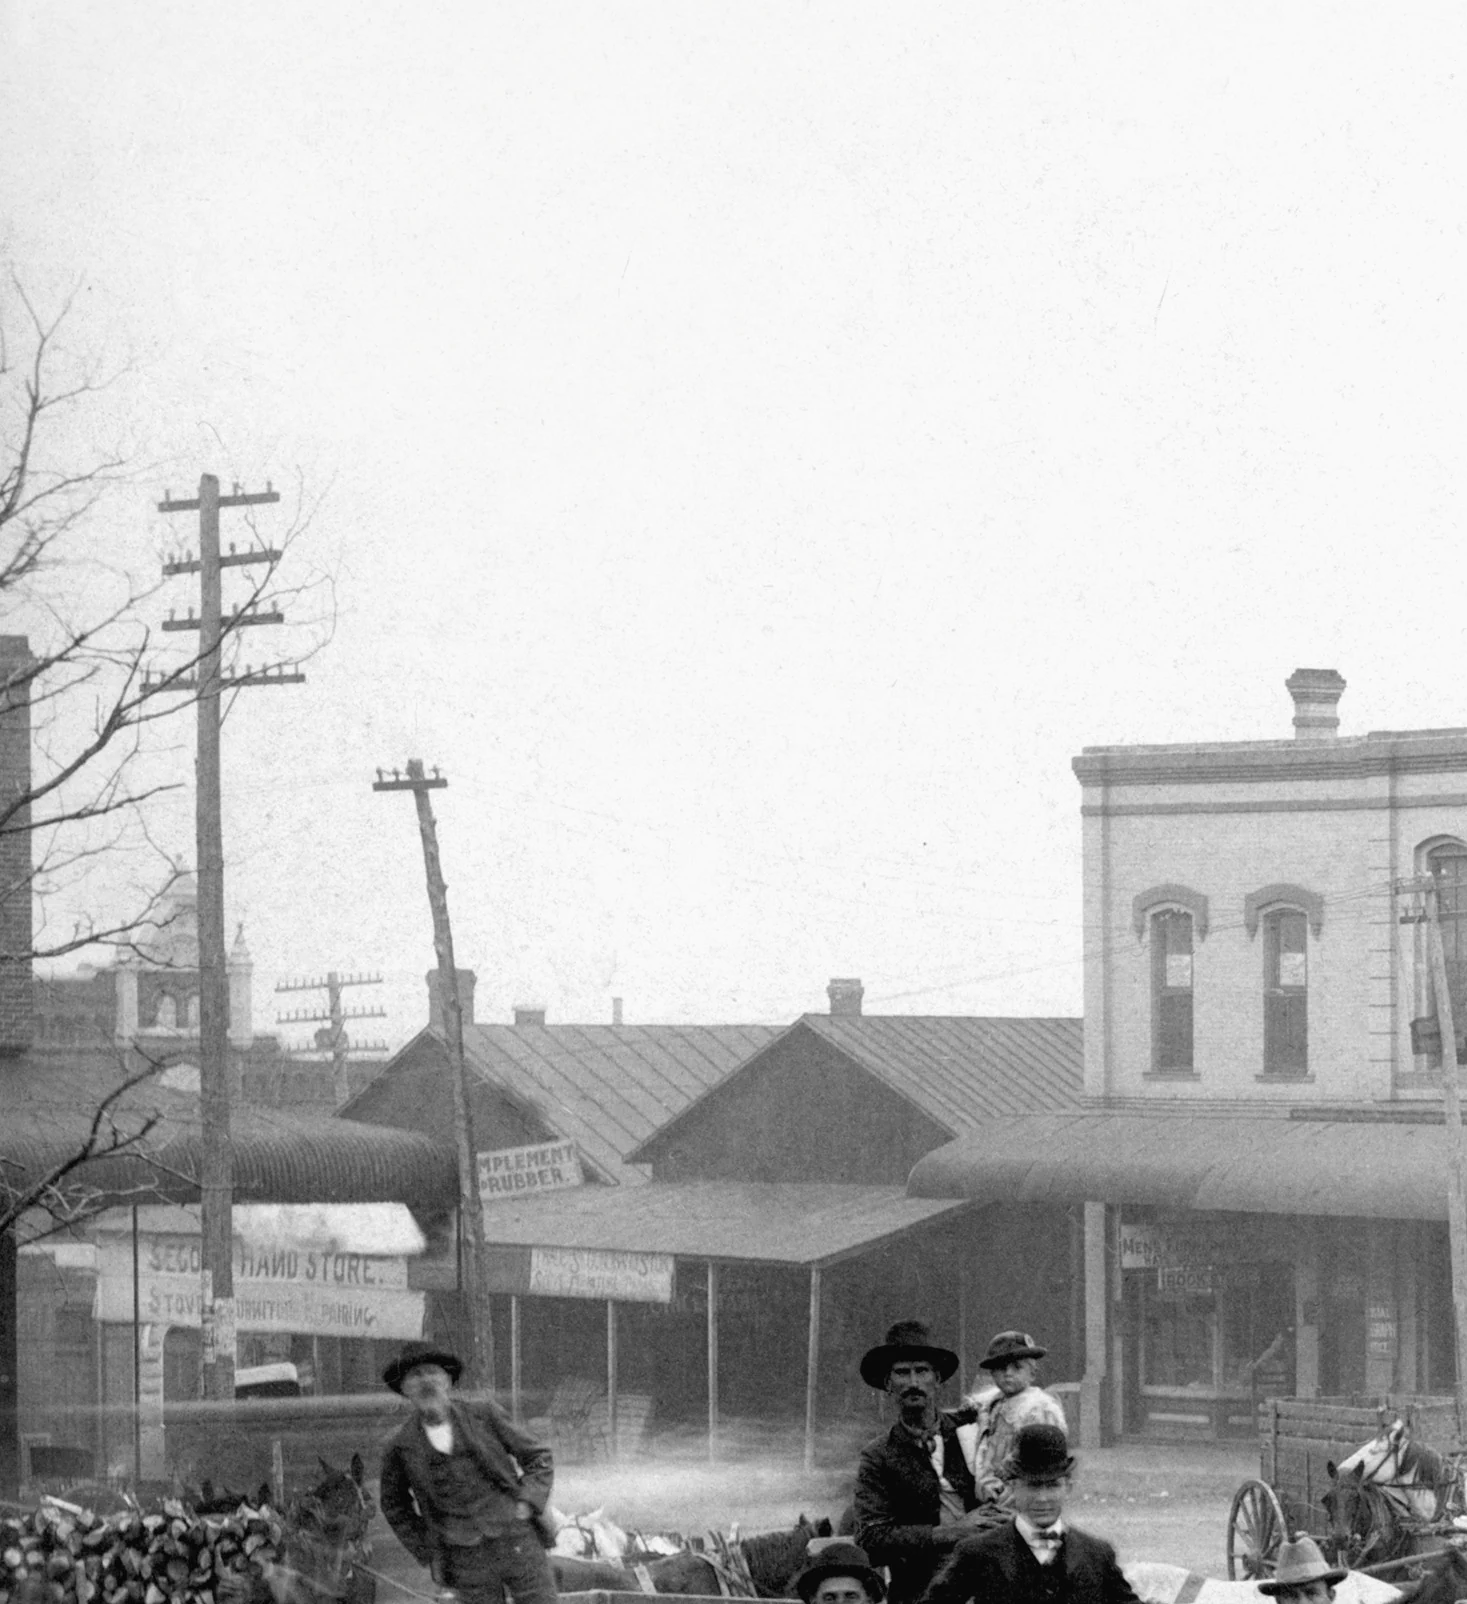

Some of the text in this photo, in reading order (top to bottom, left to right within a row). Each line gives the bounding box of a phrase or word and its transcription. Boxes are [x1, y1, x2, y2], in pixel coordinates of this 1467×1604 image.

[477, 1142, 574, 1174] MPLEMENT
[149, 1244, 202, 1273] SECO
[239, 1248, 297, 1277] HAND
